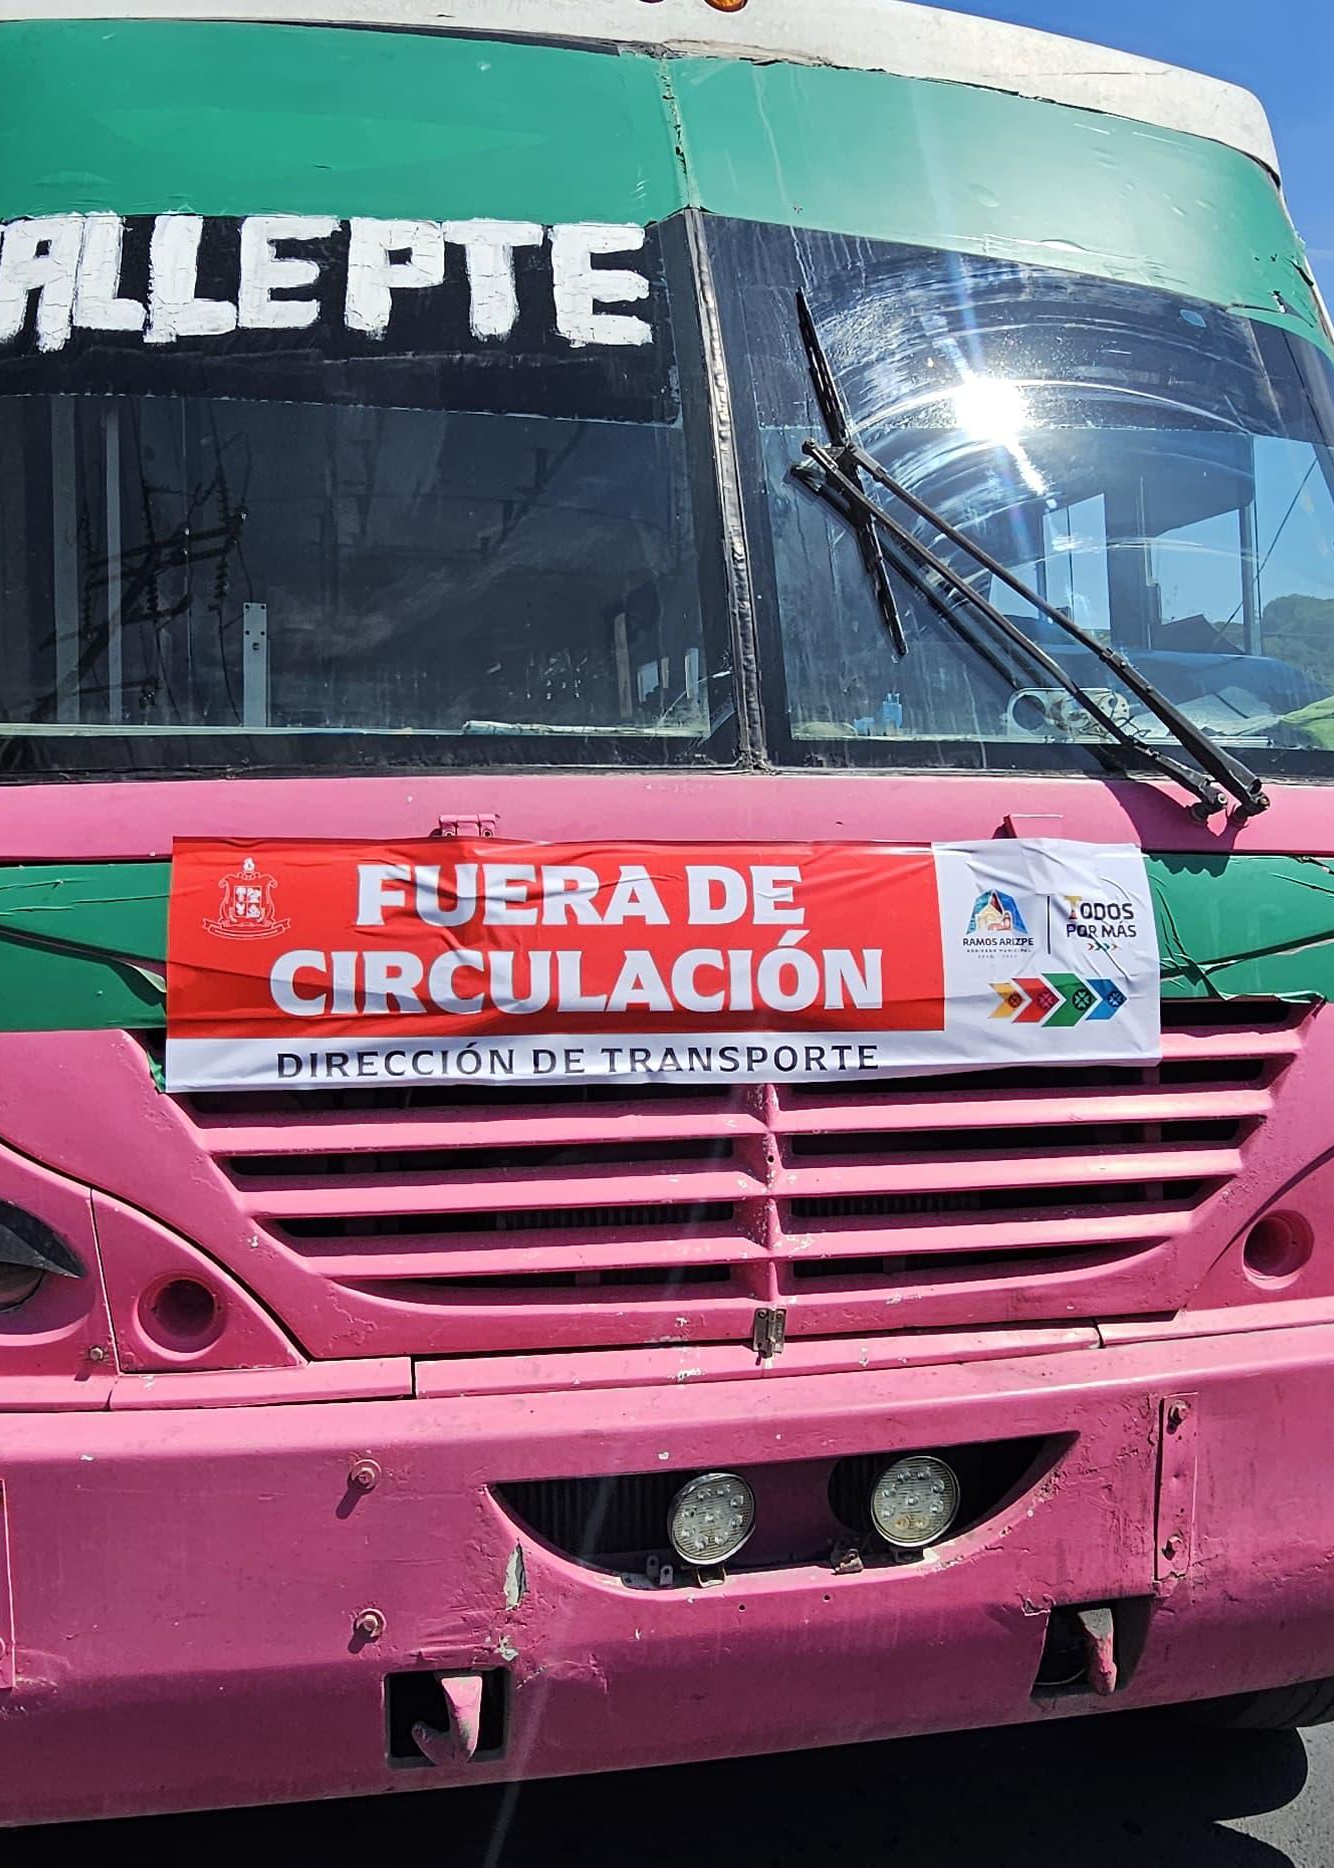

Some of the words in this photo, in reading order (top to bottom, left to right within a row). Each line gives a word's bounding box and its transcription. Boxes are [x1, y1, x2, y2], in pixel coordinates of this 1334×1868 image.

[356, 864, 670, 927] FUERA
[685, 865, 805, 925] DE
[1064, 895, 1134, 921] TODOS
[962, 937, 998, 946] RAMOS
[999, 937, 1034, 946] ARIZPE
[1066, 923, 1098, 938] POR
[1101, 920, 1137, 938] MÁS
[269, 930, 883, 1017] CIRCULACIÓN
[277, 1042, 515, 1080] DIRECCIÓN
[533, 1048, 586, 1075] DE
[601, 1044, 879, 1073] TRANSPORTE
